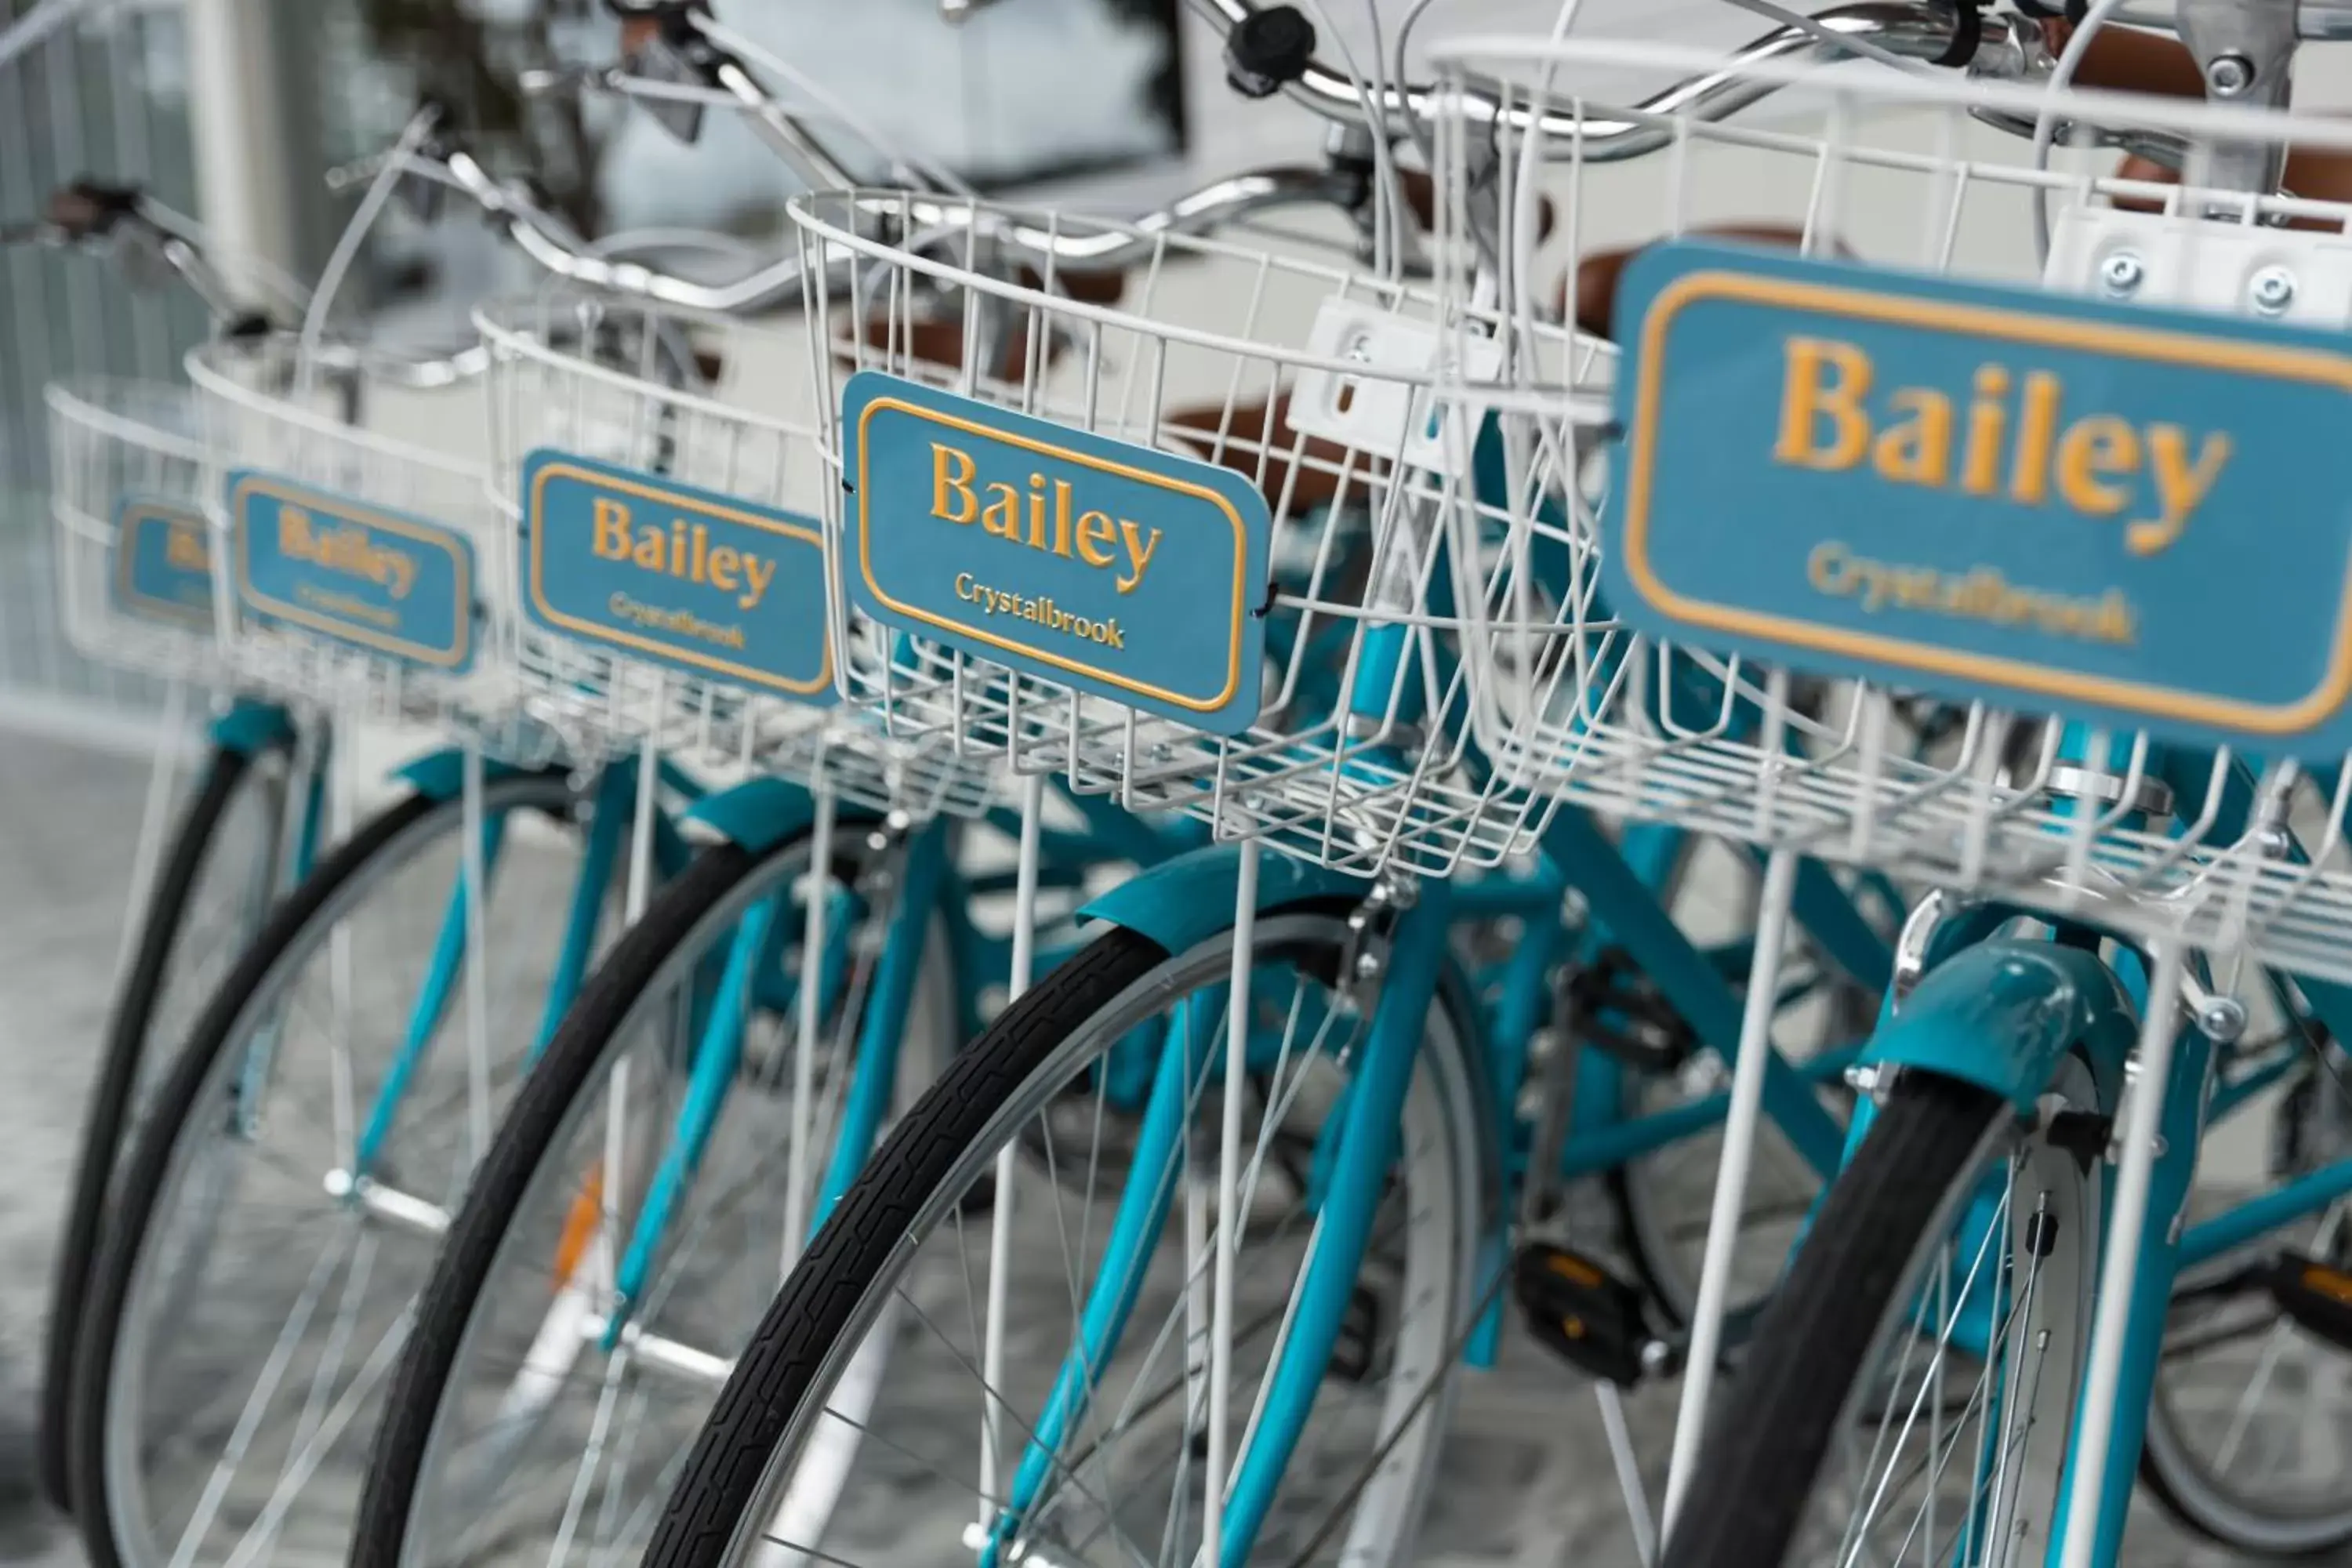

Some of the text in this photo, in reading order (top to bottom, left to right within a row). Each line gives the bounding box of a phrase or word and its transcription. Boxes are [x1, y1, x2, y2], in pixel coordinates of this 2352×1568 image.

[1773, 336, 2232, 557] Bailey
[592, 497, 776, 612] Bailey
[929, 441, 1163, 595] Bailey
[954, 572, 1124, 650] Crystalbrook
